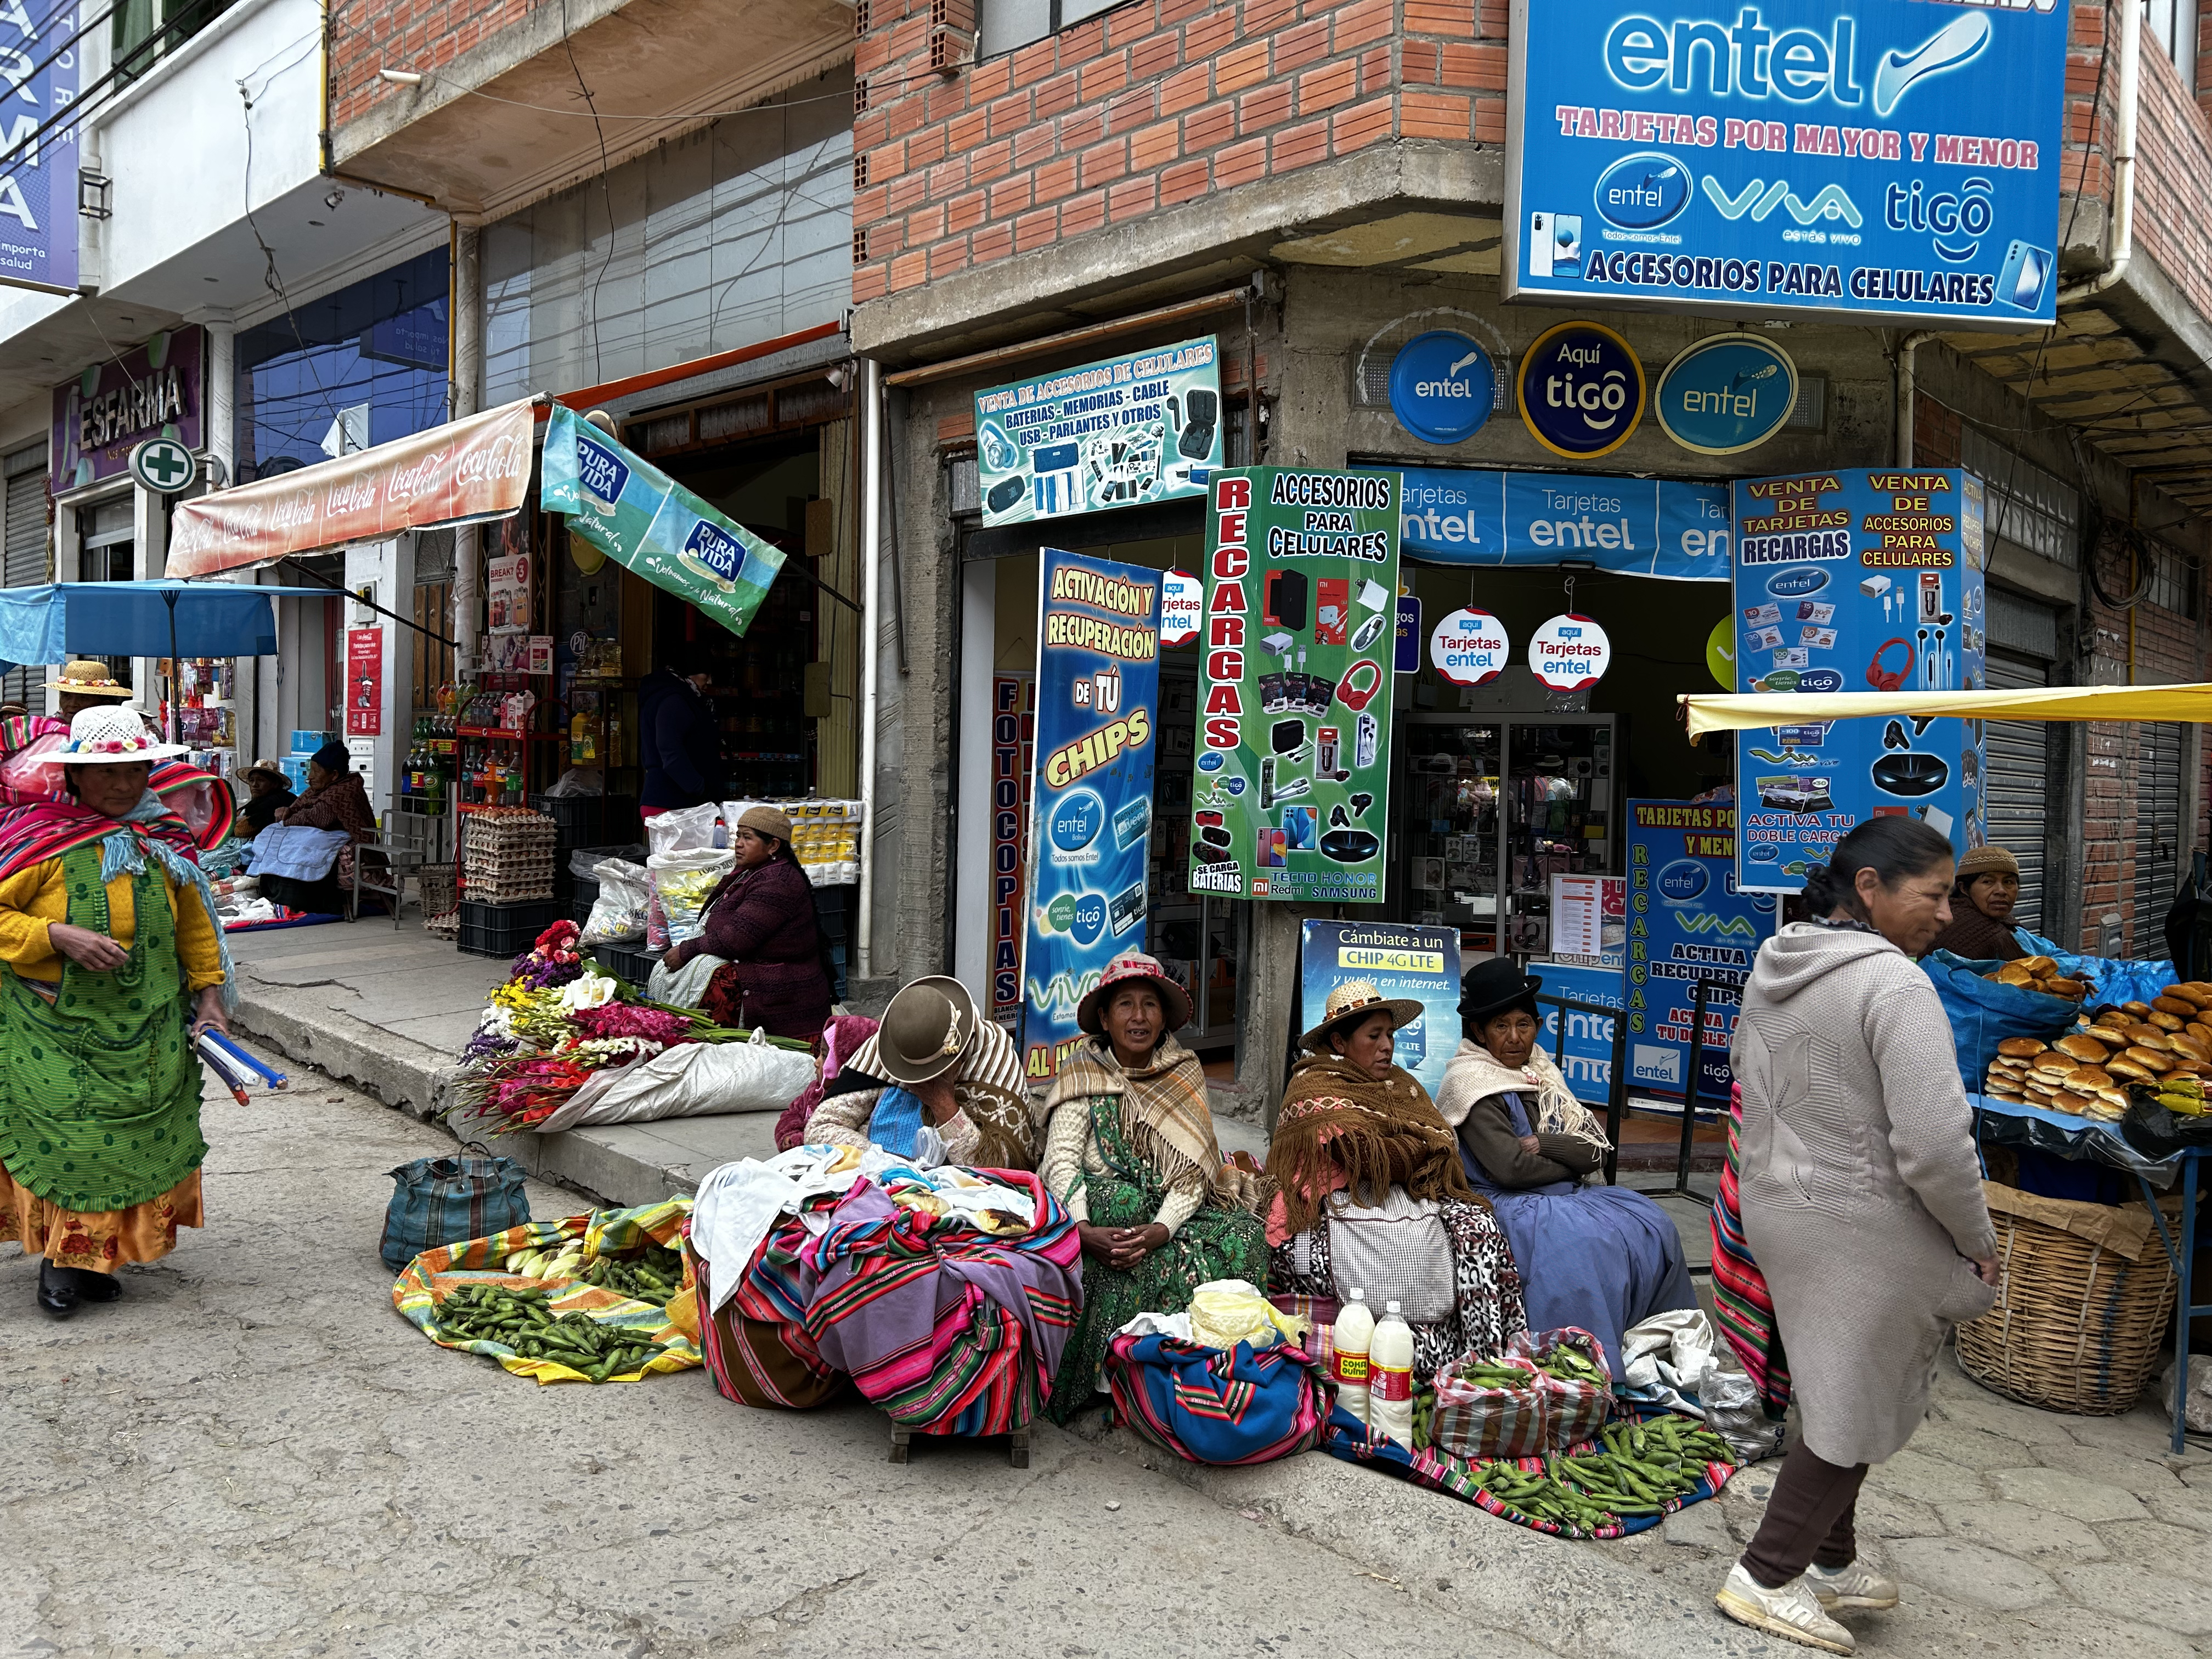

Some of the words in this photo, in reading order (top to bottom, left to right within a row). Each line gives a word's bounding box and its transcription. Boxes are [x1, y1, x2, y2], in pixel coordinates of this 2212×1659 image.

[1606, 8, 1861, 103] entel
[1557, 106, 1717, 147] TARJETAS
[1725, 119, 1786, 152] POR
[1795, 125, 1901, 161] MAYOR
[1908, 133, 1929, 162] Y
[1934, 134, 2039, 170] MENOR
[1609, 183, 1662, 207] entel
[1602, 230, 1627, 239] Todos
[1659, 234, 1682, 243] Entel
[0, 256, 32, 270] salud
[1584, 251, 1760, 291] ACCESORIOS
[1767, 264, 1842, 297] PARA
[1849, 269, 1994, 305] CELULARES
[1558, 343, 1601, 365] Aquí
[978, 388, 1018, 414] VENTA
[1019, 385, 1035, 404] DE
[1036, 366, 1113, 401] ACCESORIOS
[1114, 363, 1132, 383] DE
[1133, 343, 1214, 379] CELULARES
[1415, 377, 1471, 398] entel
[80, 365, 182, 451] ESFARMA
[1005, 407, 1055, 430] BATERIAS
[1063, 389, 1124, 417] MEMORIAS
[1132, 380, 1170, 401] CABLE
[1684, 389, 1757, 418] entel
[1019, 427, 1041, 445] USB
[1049, 414, 1110, 442] PARLANTES
[1111, 412, 1120, 426] Y
[1121, 404, 1161, 425] OTROS
[577, 440, 618, 483] PURA
[1271, 473, 1390, 509] ACCESORIOS
[1750, 477, 1840, 497] VENTA
[1870, 476, 1950, 490] VENTA
[1963, 481, 1982, 502] ACTIVA
[1402, 486, 1468, 508] arjetas
[1541, 488, 1621, 515] Tarjetas
[1778, 497, 1815, 513] DE
[1895, 497, 1928, 511] DE
[1971, 502, 1975, 515] Y
[1305, 511, 1353, 533] PARA
[1403, 509, 1481, 545] ntel
[1743, 511, 1848, 532] TARJETAS
[1865, 517, 1952, 531] ACCESORIOS
[699, 524, 736, 562] PURA
[1529, 516, 1635, 551] entel
[1884, 535, 1936, 548] PARA
[1963, 532, 1968, 546] TU
[1970, 535, 1982, 552] CHIPS
[1268, 526, 1387, 562] CELULARES
[1742, 532, 1849, 565] RECARGAS
[699, 542, 733, 577] VIDA
[1863, 551, 1953, 566] CELULARES
[490, 567, 514, 578] BREAK?
[1052, 568, 1139, 615] ACTIVACIÓN
[1143, 586, 1154, 616] Y
[1167, 584, 1181, 593] aquí
[1775, 579, 1810, 589] entel
[699, 589, 742, 618] Natural
[1204, 477, 1251, 750] RECARGAS
[1161, 614, 1193, 629] ntel
[1463, 621, 1479, 629] aquí
[573, 635, 587, 653] Pil
[1048, 613, 1155, 658] RECUPERACIÓN
[1439, 636, 1502, 652] Tarjetas
[1446, 652, 1493, 667] entel
[1537, 641, 1601, 658] Tarjetas
[1543, 660, 1592, 675] entel
[1075, 681, 1090, 704] DE
[1096, 665, 1120, 712] TÚ
[1046, 710, 1150, 787] CHIPS
[1058, 815, 1087, 833] entel
[1637, 807, 1712, 827] TARJETAS
[1747, 814, 1822, 827] ACTIVA
[1826, 814, 1854, 827] TU
[995, 682, 1018, 1002] FOTOCOPIAS
[1686, 836, 1695, 854] Y
[1748, 830, 1796, 842] DOBLE
[1052, 853, 1067, 862] Todos
[1068, 854, 1084, 862] somos
[1085, 853, 1098, 861] Entel
[1198, 866, 1209, 874] SE
[1209, 862, 1239, 873] CARGA
[1193, 871, 1242, 893] BATERIAS
[1271, 872, 1317, 883] TECNO
[1322, 872, 1376, 885] HONOR
[1664, 876, 1693, 889] entel
[1271, 885, 1304, 895] Redmi
[1312, 887, 1376, 899] SAMSUNG
[1057, 912, 1074, 922] tienes
[1339, 929, 1409, 947] Cámbiate
[1412, 939, 1421, 947] a
[1424, 939, 1443, 949] un
[1629, 844, 1650, 1033] RECARGAS
[1346, 951, 1384, 965] CHIP
[1387, 953, 1406, 967] 4G
[1409, 955, 1435, 968] LTE
[1671, 943, 1747, 965] ACTIVA
[1331, 975, 1341, 987] y
[1344, 973, 1378, 986] vuela
[1380, 978, 1396, 988] en
[1399, 977, 1451, 991] internet.
[1650, 961, 1751, 985] RECUPERA
[994, 1005, 1018, 1014] BLANCO
[1053, 1012, 1076, 1021] Estamos
[1669, 1008, 1724, 1029] ACTVA
[1545, 1011, 1615, 1042] ente
[1656, 1024, 1677, 1041] TU
[1026, 1047, 1051, 1078] AL
[1636, 1065, 1673, 1080] entel
[1342, 1359, 1366, 1368] COKA
